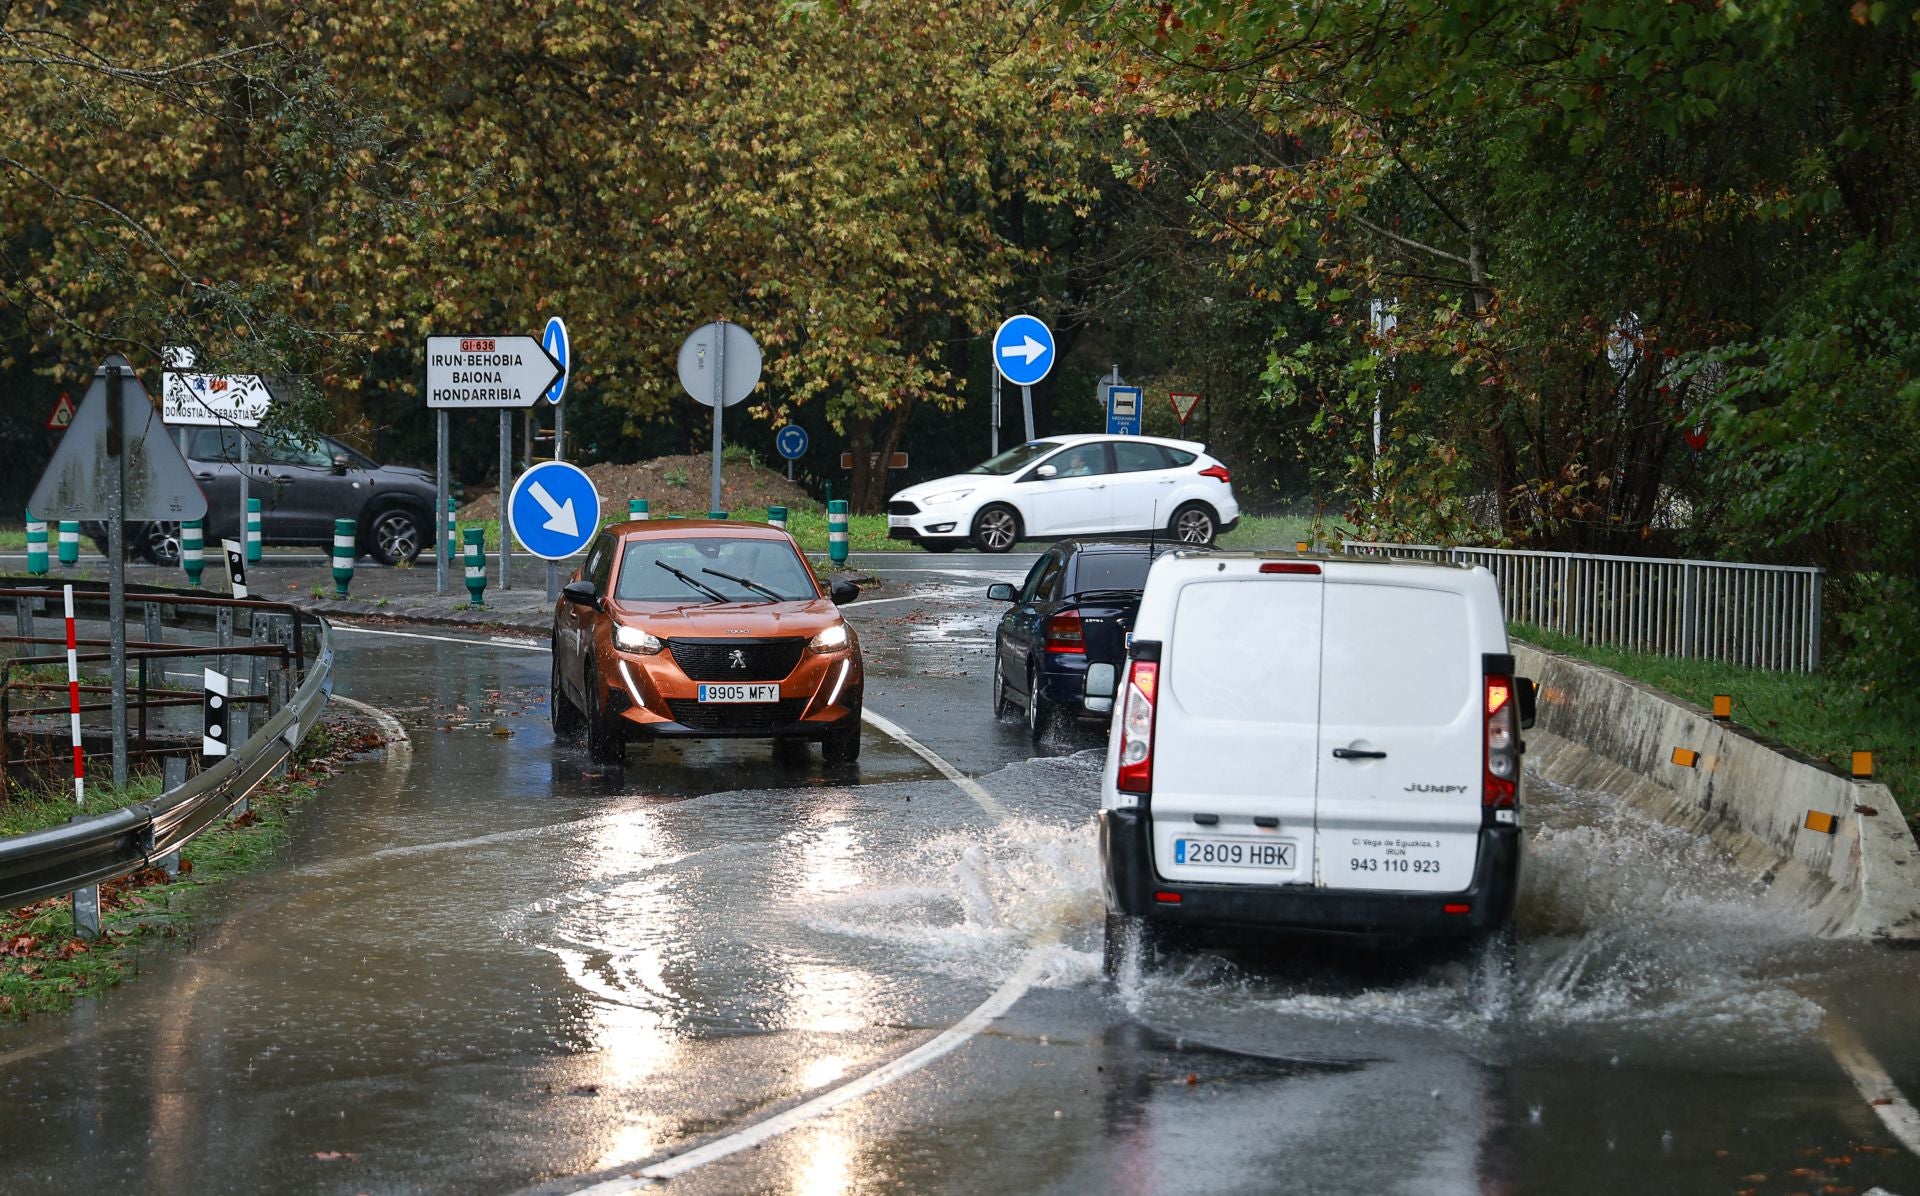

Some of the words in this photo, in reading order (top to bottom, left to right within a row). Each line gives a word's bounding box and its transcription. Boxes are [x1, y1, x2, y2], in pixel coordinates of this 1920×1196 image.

[462, 341, 494, 351] GI-636
[432, 354, 522, 367] IRUN-BEHOBIA
[452, 371, 502, 384] BAIONA
[433, 388, 521, 401] HONDARRIBIA
[708, 686, 744, 700] 9905
[749, 686, 775, 700] MFY
[1403, 783, 1468, 794] JUMPY
[1363, 839, 1382, 848] Vega
[1384, 839, 1394, 847] de
[1435, 840, 1441, 848] 3
[1189, 843, 1242, 863] 2809
[1249, 845, 1289, 866] HBK
[1385, 848, 1406, 856] IRUN
[1350, 858, 1378, 871] 943
[1383, 859, 1409, 872] 110
[1413, 860, 1440, 873] 923
